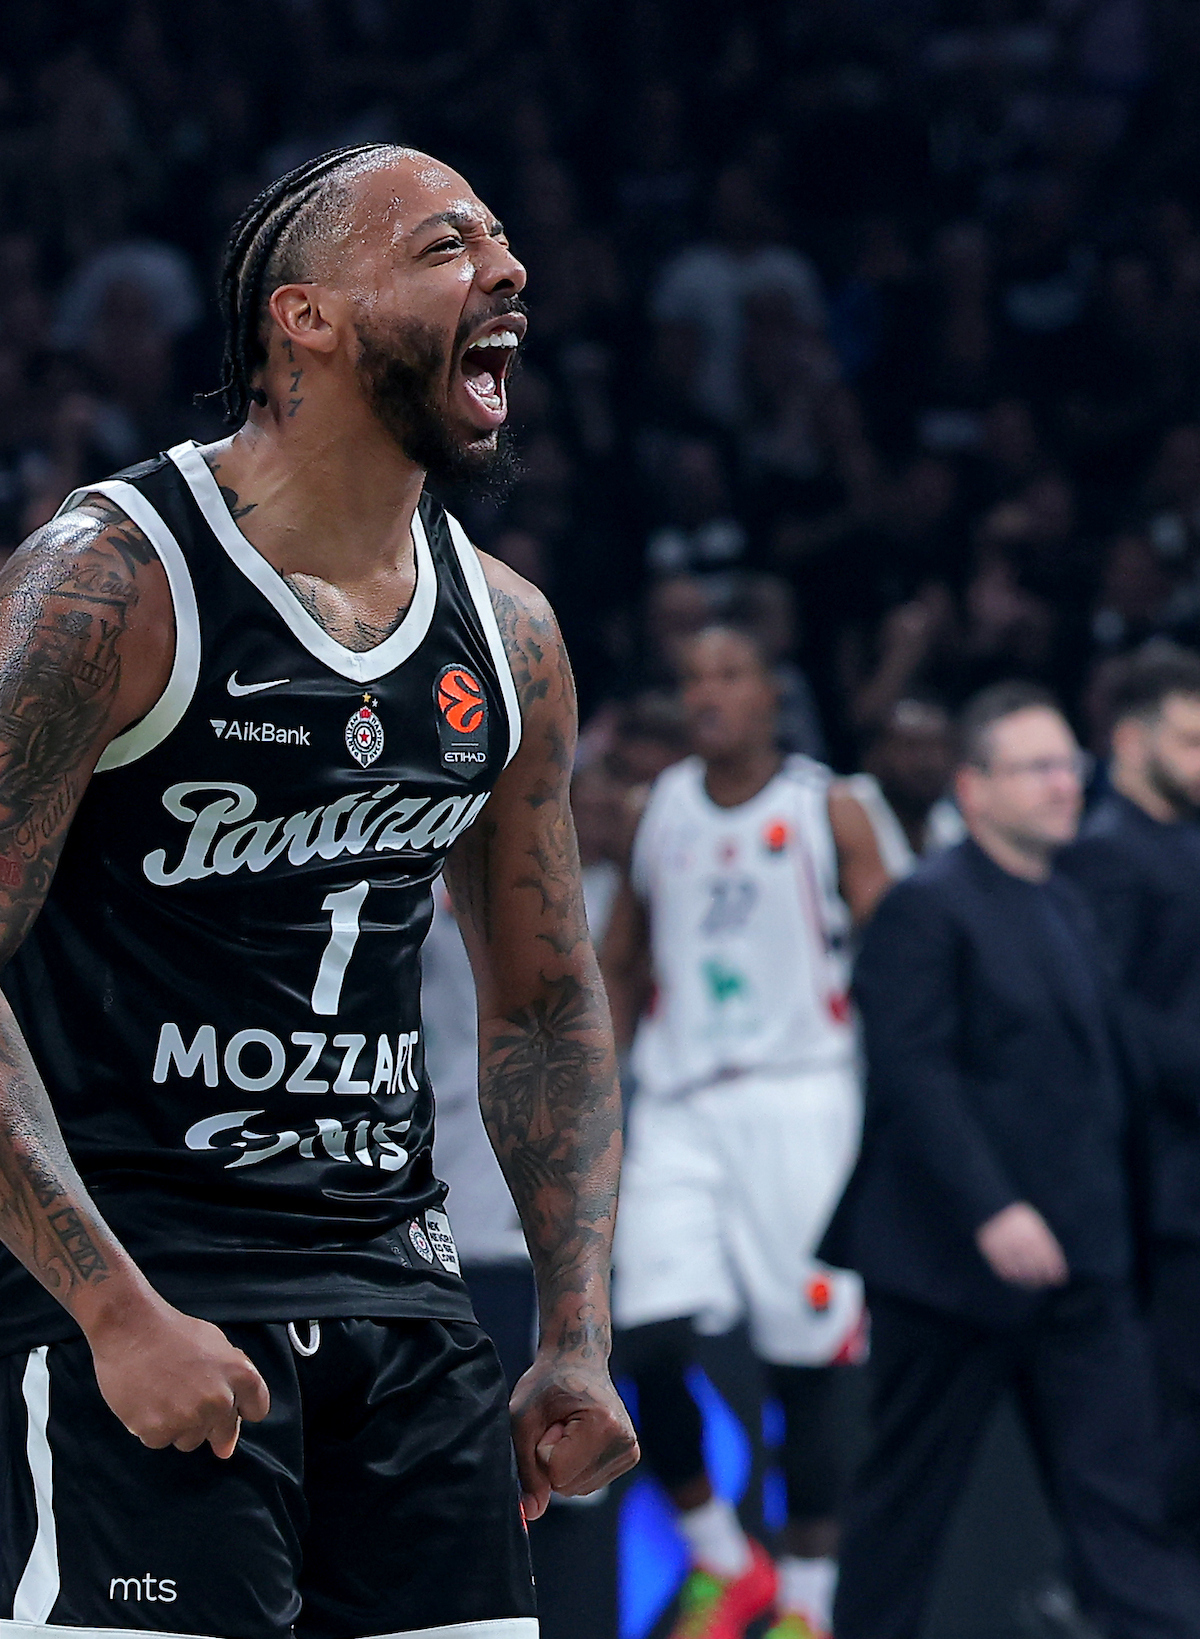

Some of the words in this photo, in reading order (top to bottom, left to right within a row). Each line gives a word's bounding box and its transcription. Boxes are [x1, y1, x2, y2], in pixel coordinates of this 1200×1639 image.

[225, 720, 311, 746] AikBank
[444, 751, 486, 764] ETIHAD
[143, 781, 491, 887] Partizan
[311, 880, 370, 1016] 1
[152, 1022, 420, 1095] MOZZART
[300, 1118, 411, 1172] NIS
[109, 1572, 178, 1603] mts
